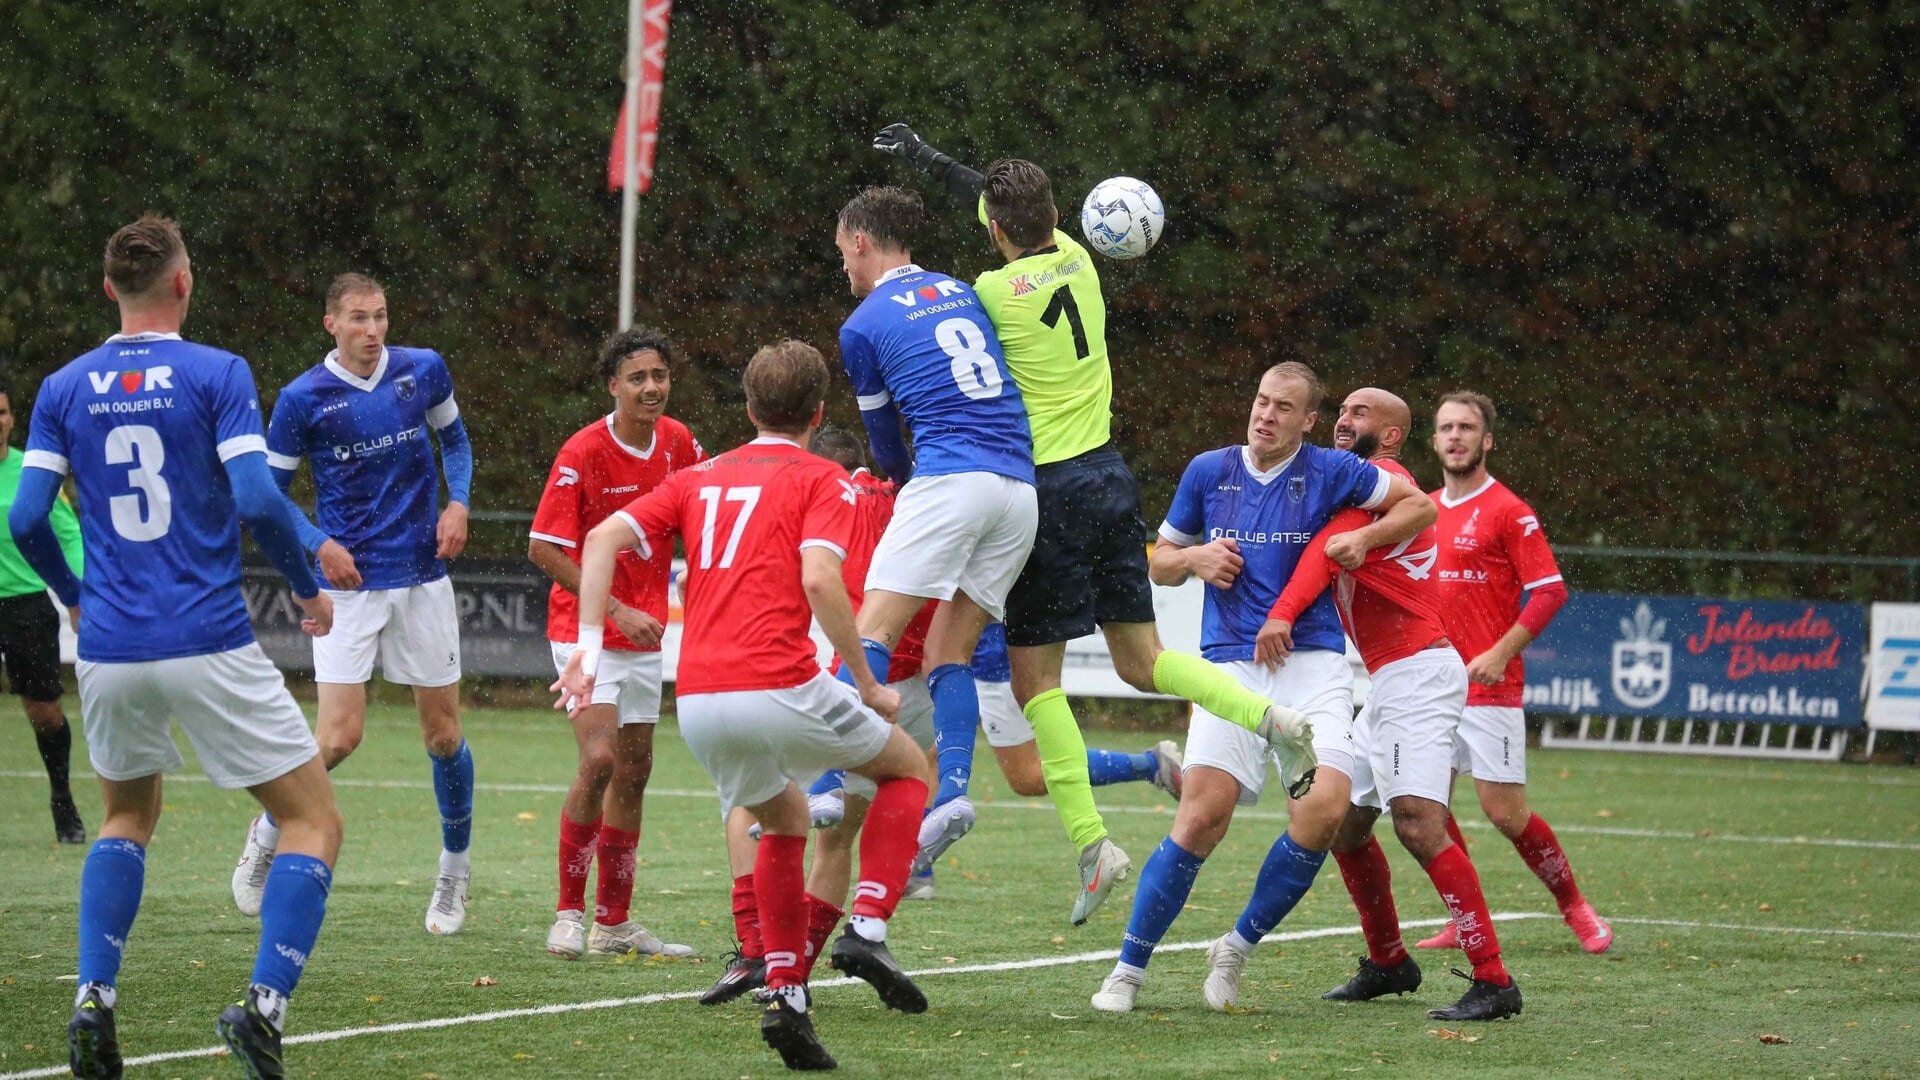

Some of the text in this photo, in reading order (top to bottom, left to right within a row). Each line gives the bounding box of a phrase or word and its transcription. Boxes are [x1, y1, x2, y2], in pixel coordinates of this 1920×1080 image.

[906, 297, 975, 320] VAN OOIJEN B.V.
[1040, 284, 1090, 360] 1
[935, 317, 1003, 400] 8
[88, 397, 174, 415] VAN OOIJEN B.V.
[322, 401, 348, 413] KELME
[353, 435, 394, 453] CLUB
[105, 425, 171, 542] 3
[610, 485, 639, 494] PATRICK
[700, 486, 762, 569] 17
[1225, 529, 1267, 543] CLUB
[1687, 605, 1834, 654] Jolanda
[1726, 635, 1842, 680] Brand
[1688, 683, 1839, 717] Betrokken
